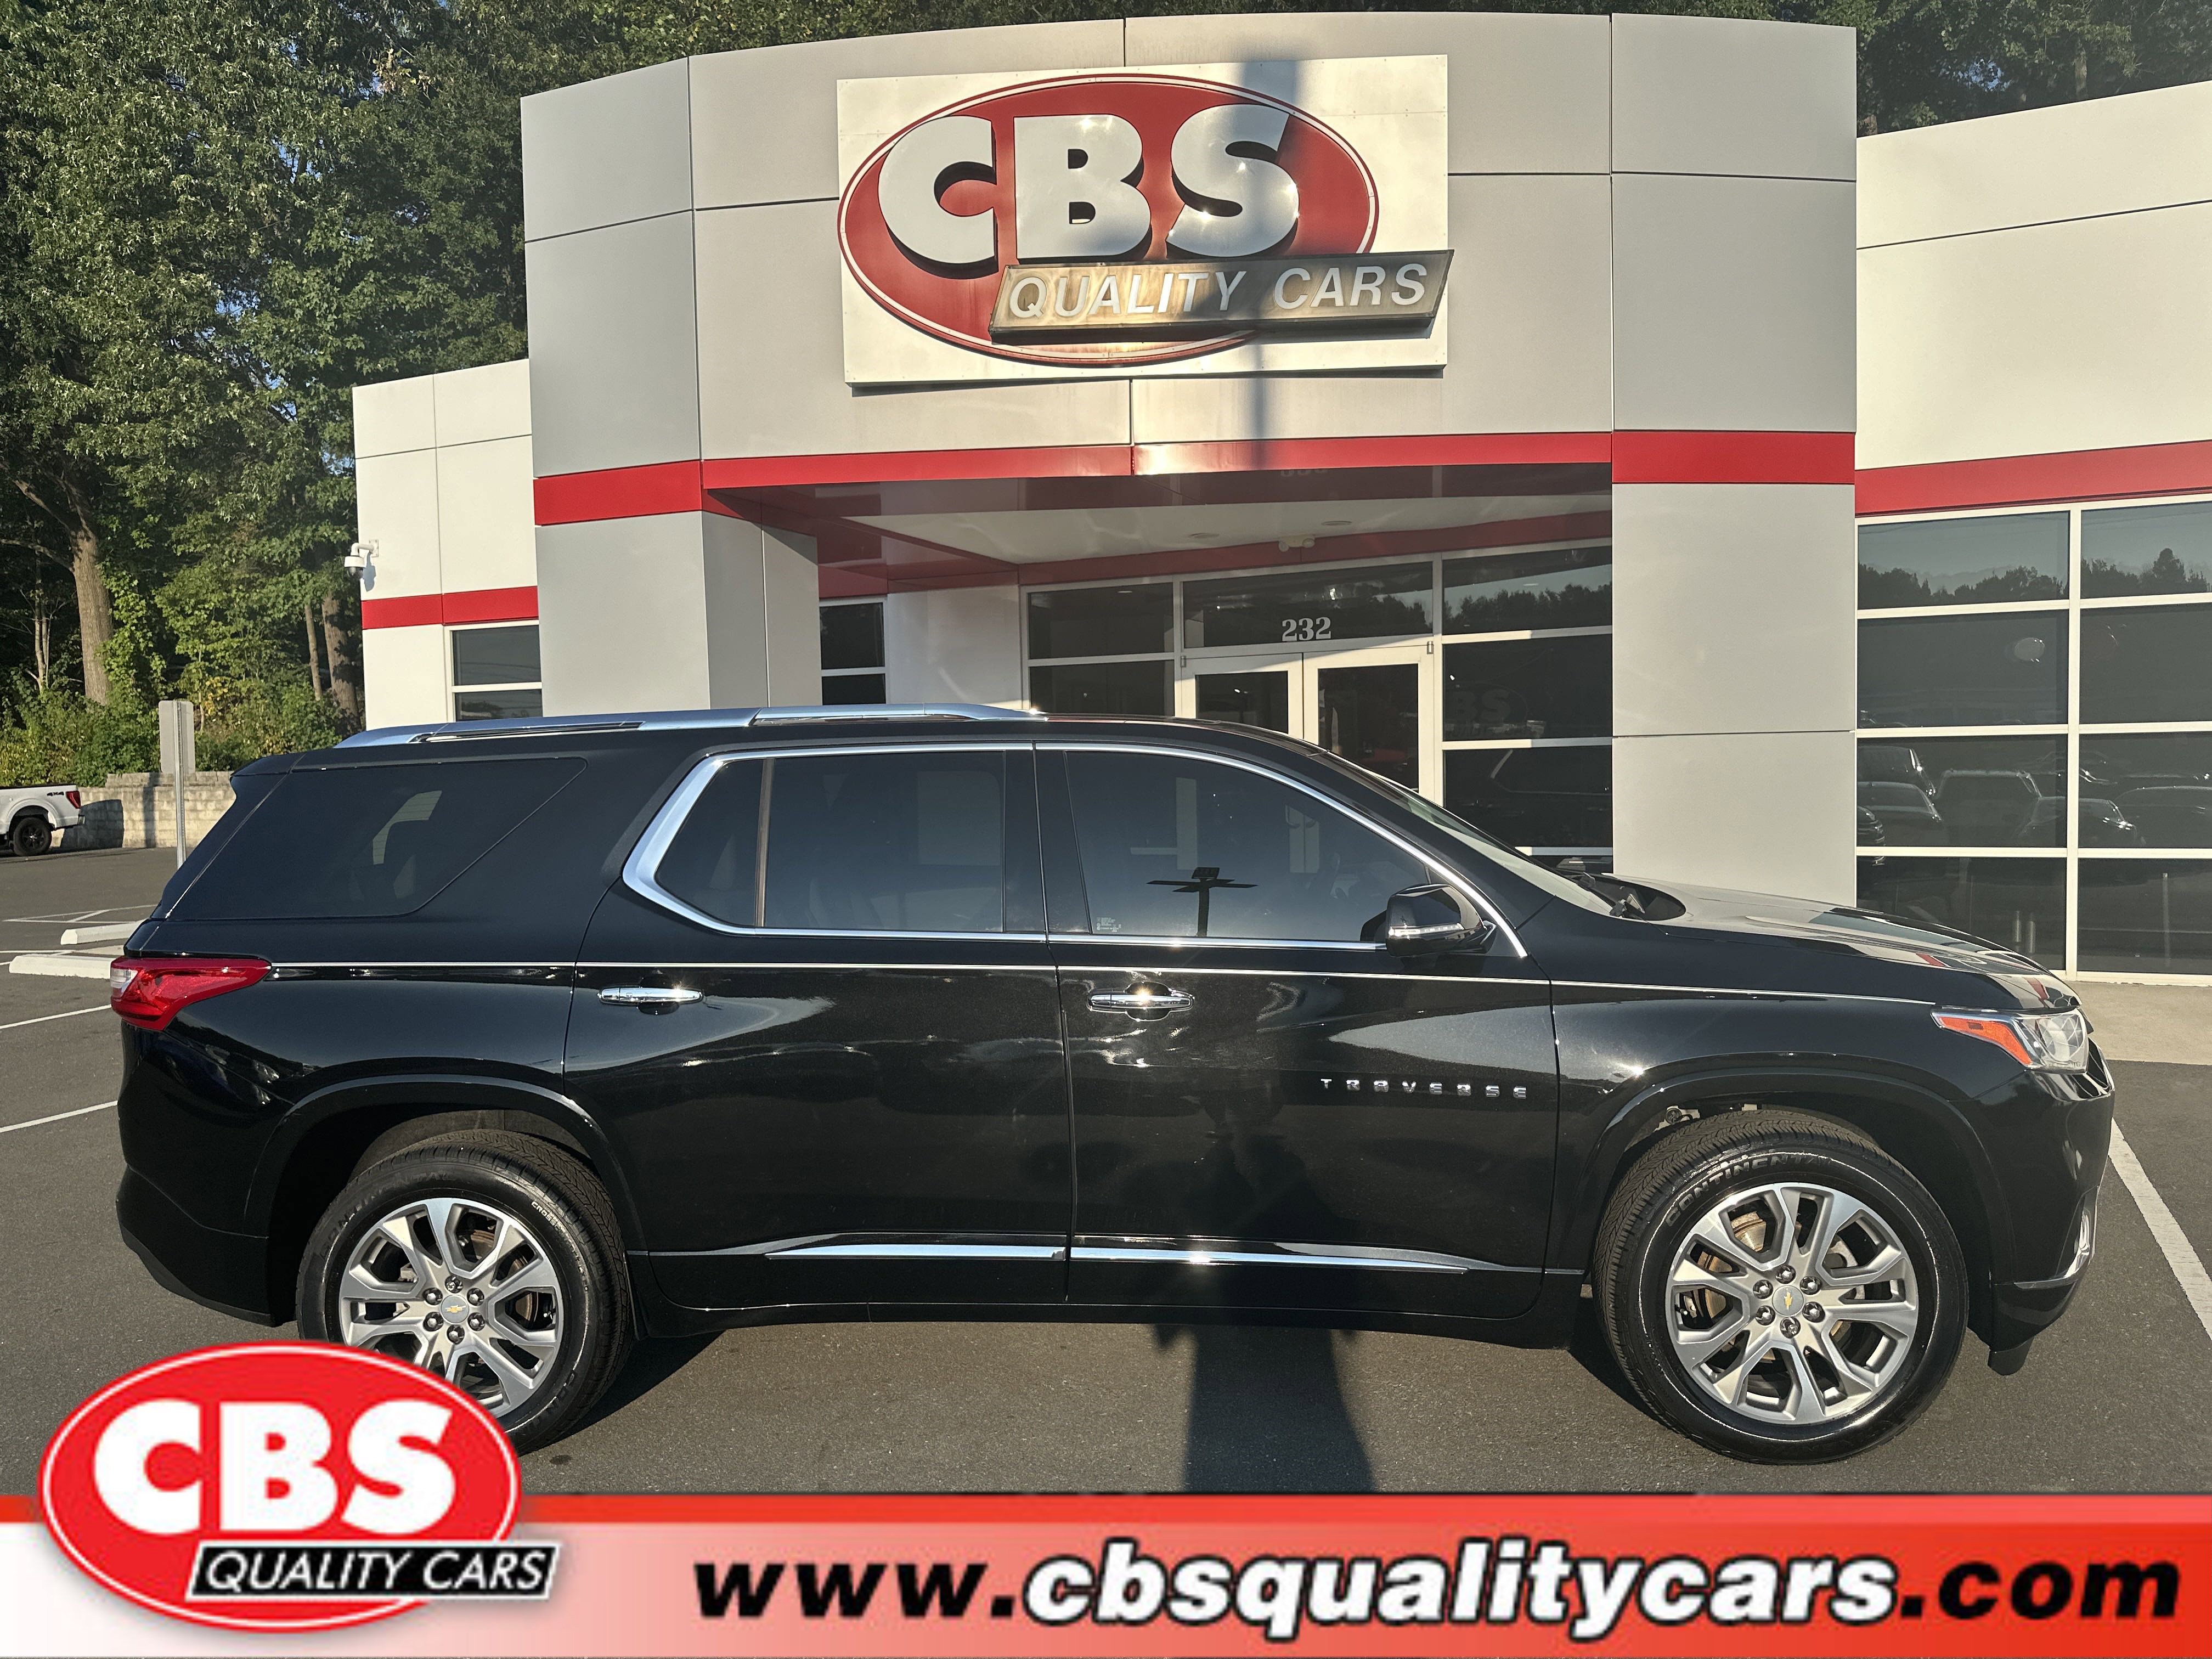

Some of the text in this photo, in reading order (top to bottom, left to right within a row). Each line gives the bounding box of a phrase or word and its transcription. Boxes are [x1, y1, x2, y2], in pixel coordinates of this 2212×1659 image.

[878, 103, 1299, 266] CBS
[1008, 263, 1427, 318] QUALITY CARS
[1281, 616, 1332, 642] 232
[1320, 1078, 1527, 1099] TRAVERSE
